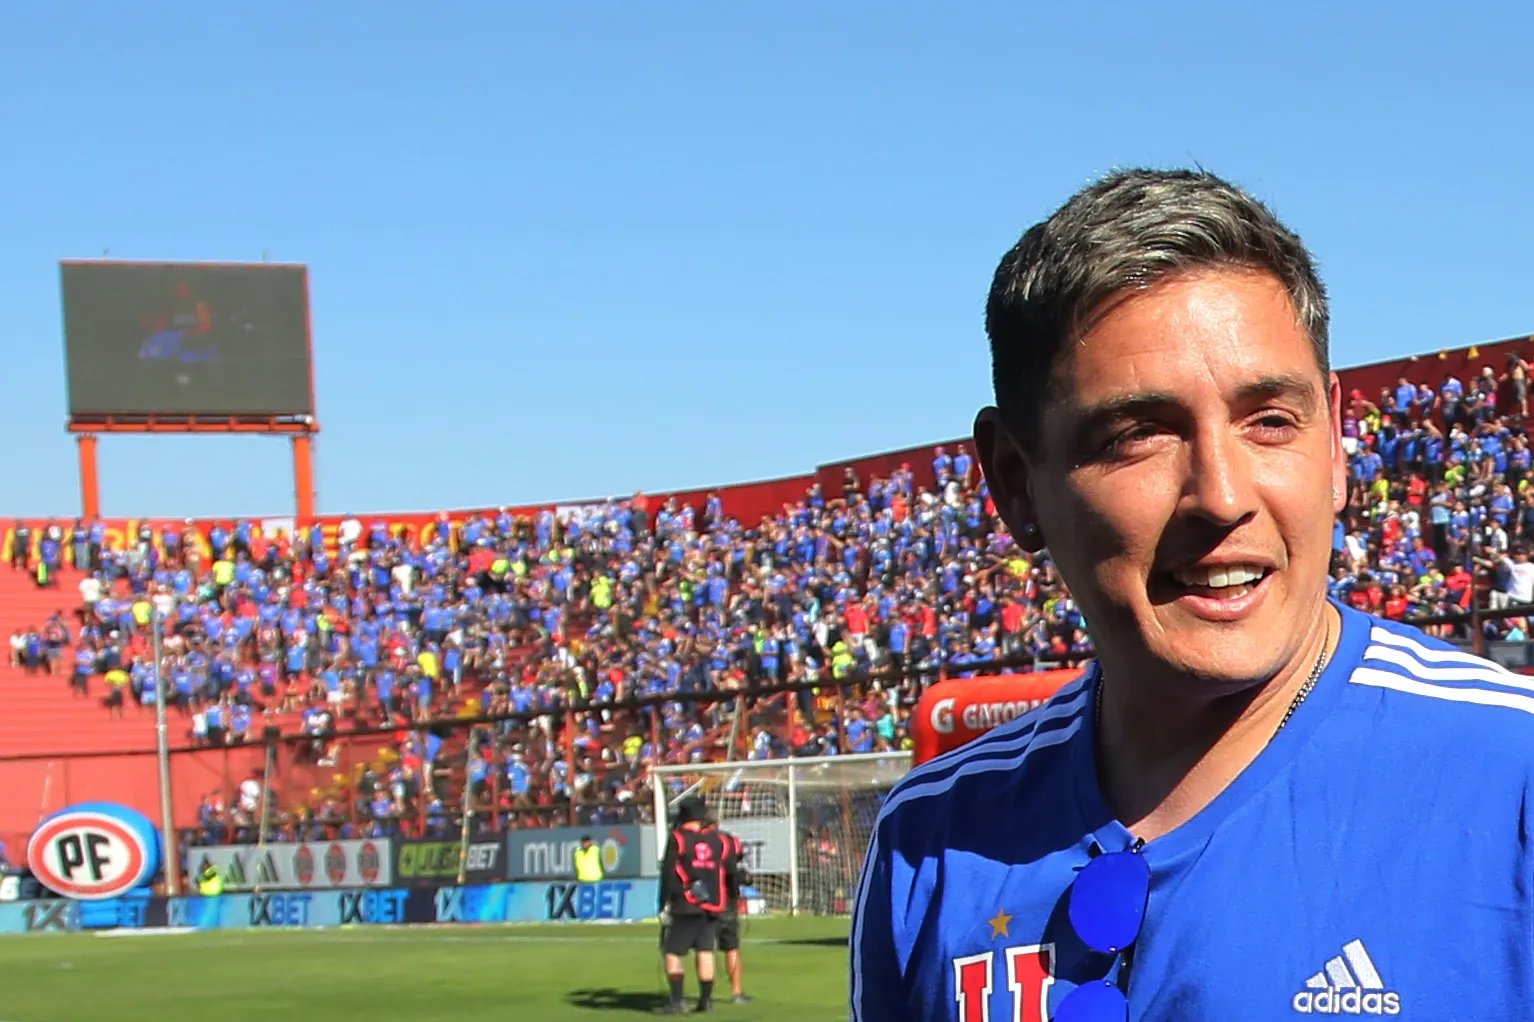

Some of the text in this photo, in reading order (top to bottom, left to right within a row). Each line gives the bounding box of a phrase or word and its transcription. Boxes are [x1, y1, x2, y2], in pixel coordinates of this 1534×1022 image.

[57, 831, 111, 883] PF
[523, 838, 619, 874] muno
[248, 893, 313, 926] 1XBET
[337, 888, 410, 923] 1XBET
[546, 882, 632, 919] 1XBET
[1292, 985, 1401, 1015] adidas
